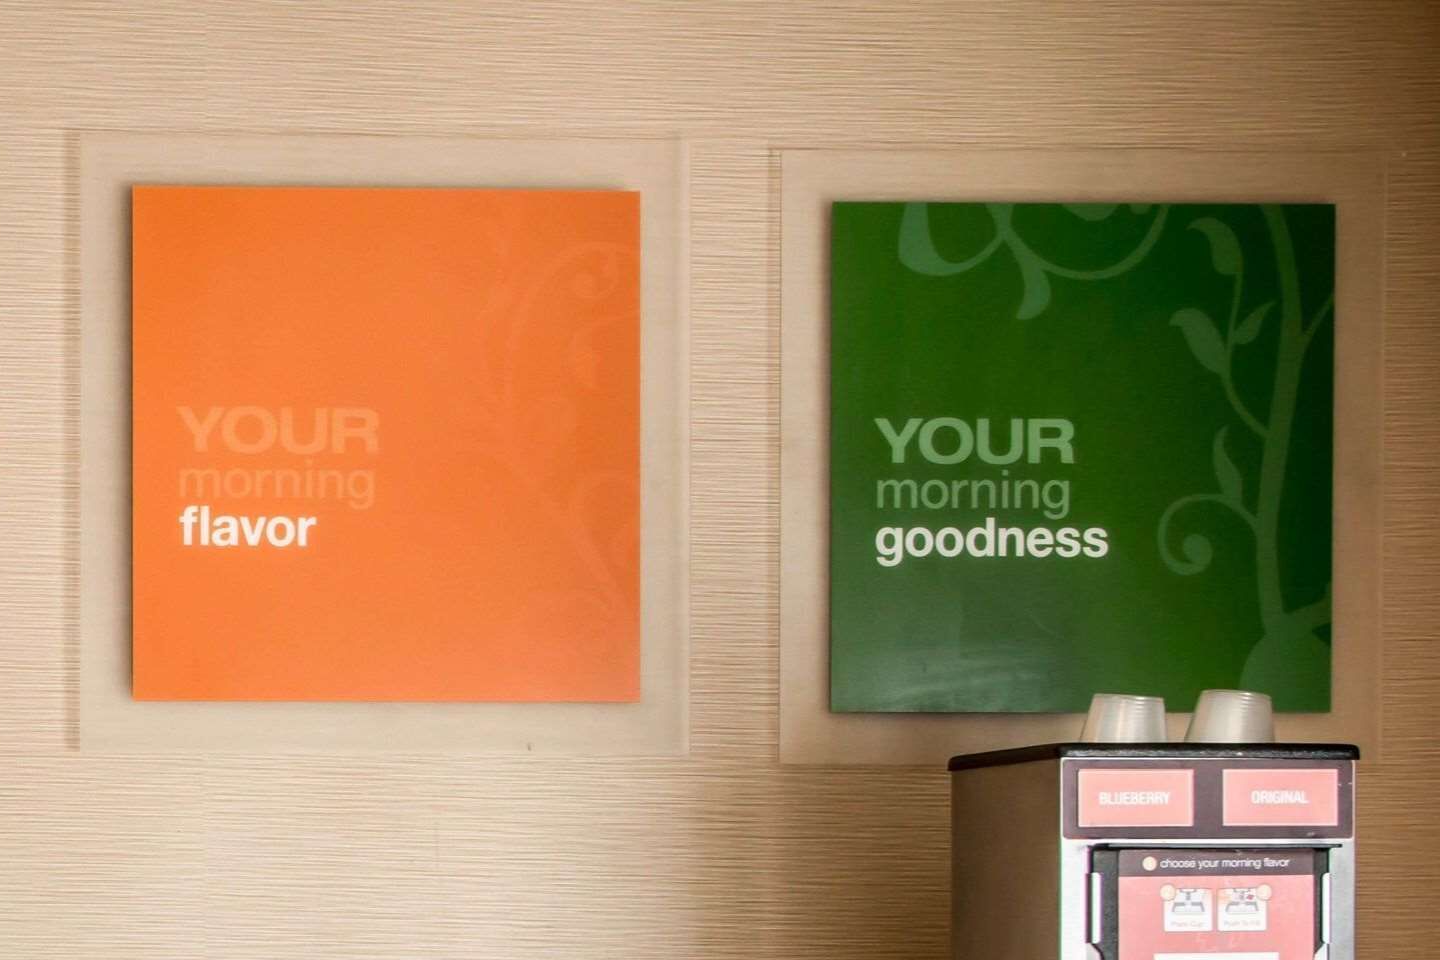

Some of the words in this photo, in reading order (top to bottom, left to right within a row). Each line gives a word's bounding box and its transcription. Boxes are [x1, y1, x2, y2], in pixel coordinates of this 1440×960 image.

[176, 406, 380, 454] YOUR
[874, 417, 1075, 465] YOUR
[178, 459, 375, 510] morning
[876, 469, 1070, 520] morning
[179, 505, 317, 547] flavor
[875, 517, 1109, 567] goodness
[1098, 791, 1171, 806] BLUEBERRY
[1251, 790, 1308, 805] ORIGINAL
[1160, 858, 1196, 869] choose
[1198, 860, 1220, 870] your
[1222, 857, 1261, 870] morning
[1263, 857, 1290, 867] flavor
